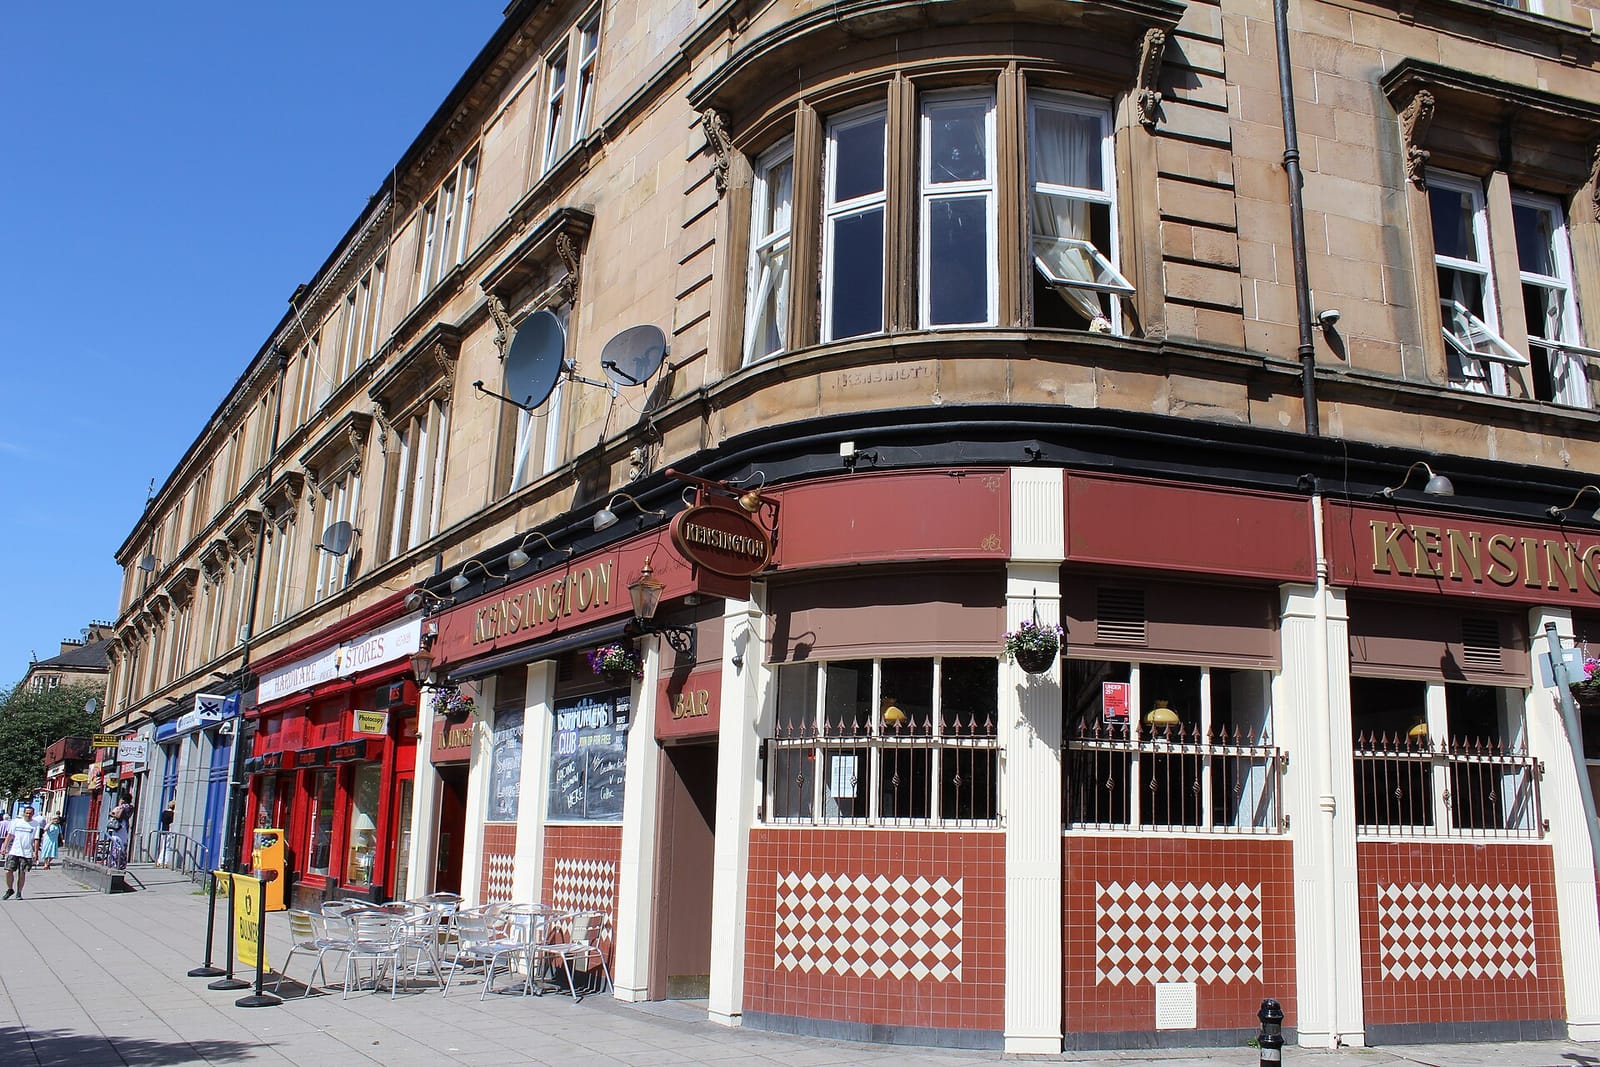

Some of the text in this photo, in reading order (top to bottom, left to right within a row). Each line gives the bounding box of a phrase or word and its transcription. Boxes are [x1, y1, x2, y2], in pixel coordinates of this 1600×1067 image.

[686, 522, 764, 558] KENSINGTON
[472, 559, 613, 646] KENSINGTON
[344, 637, 385, 669] STORES
[673, 689, 710, 721] BAR
[358, 714, 384, 725] Photocopy
[364, 723, 376, 731] here
[558, 730, 577, 755] CLUB
[566, 786, 584, 808] HERE
